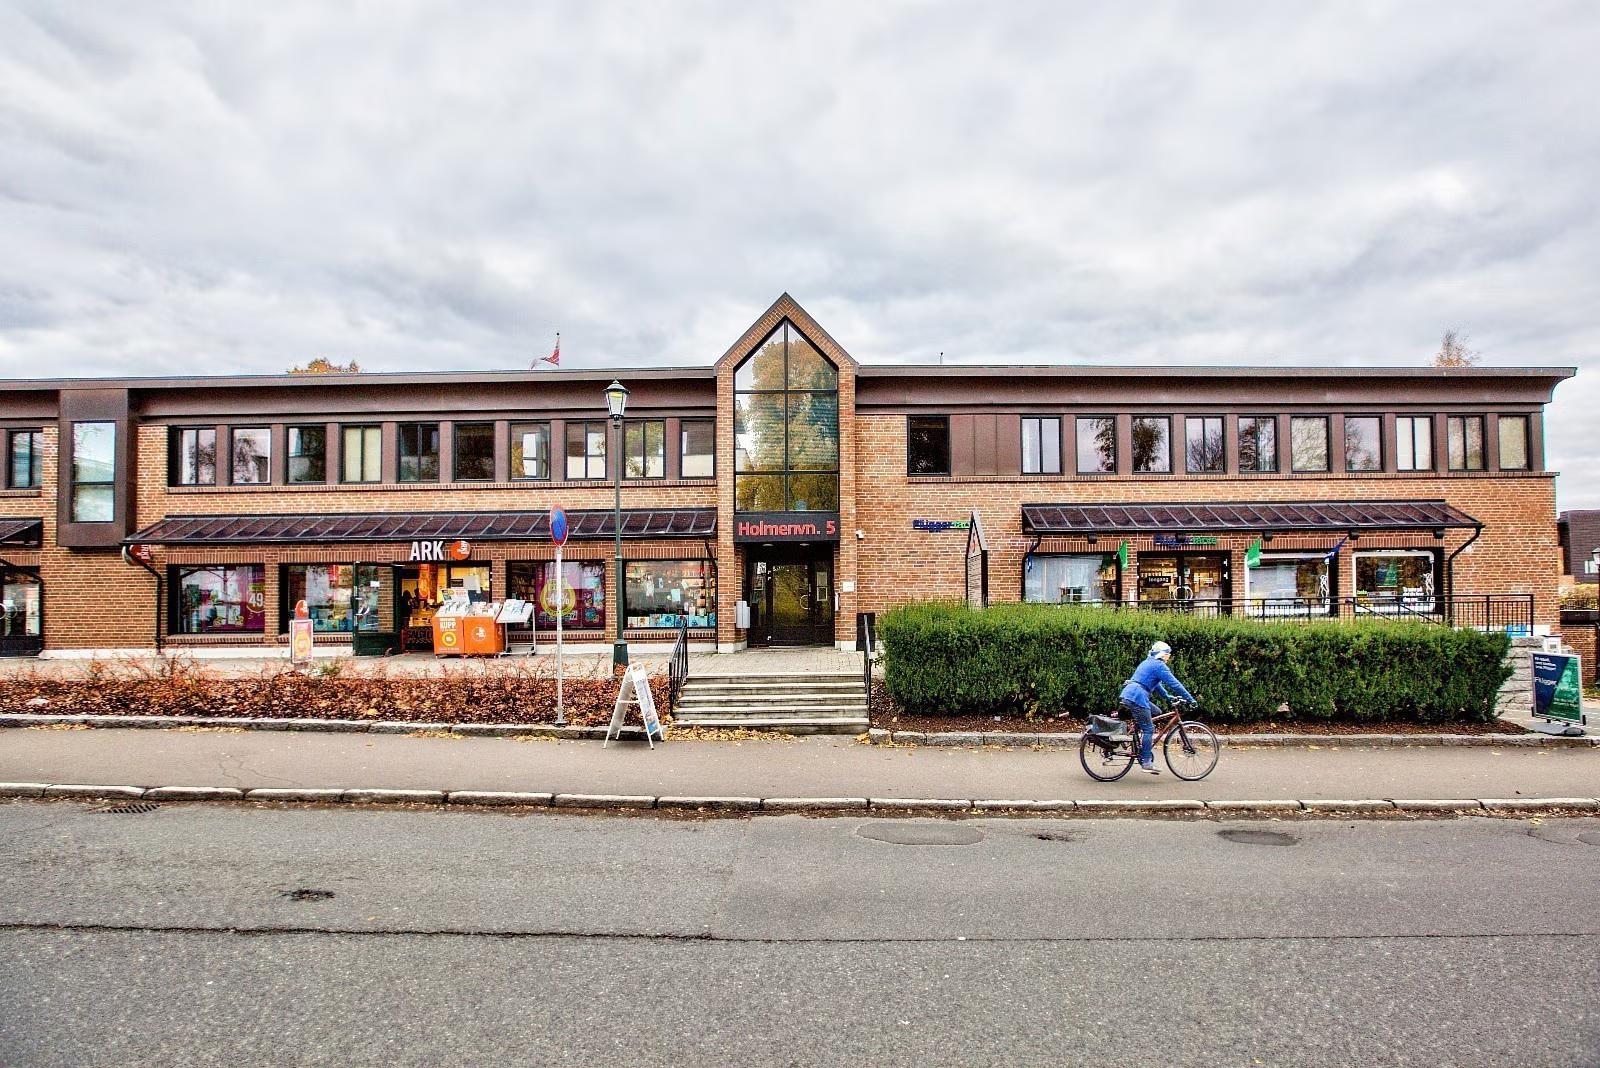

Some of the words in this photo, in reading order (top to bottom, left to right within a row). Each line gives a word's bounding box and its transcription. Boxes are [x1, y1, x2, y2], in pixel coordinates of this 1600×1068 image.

[739, 520, 821, 536] Holmenvn.
[826, 520, 836, 535] 5
[410, 540, 444, 561] ARK
